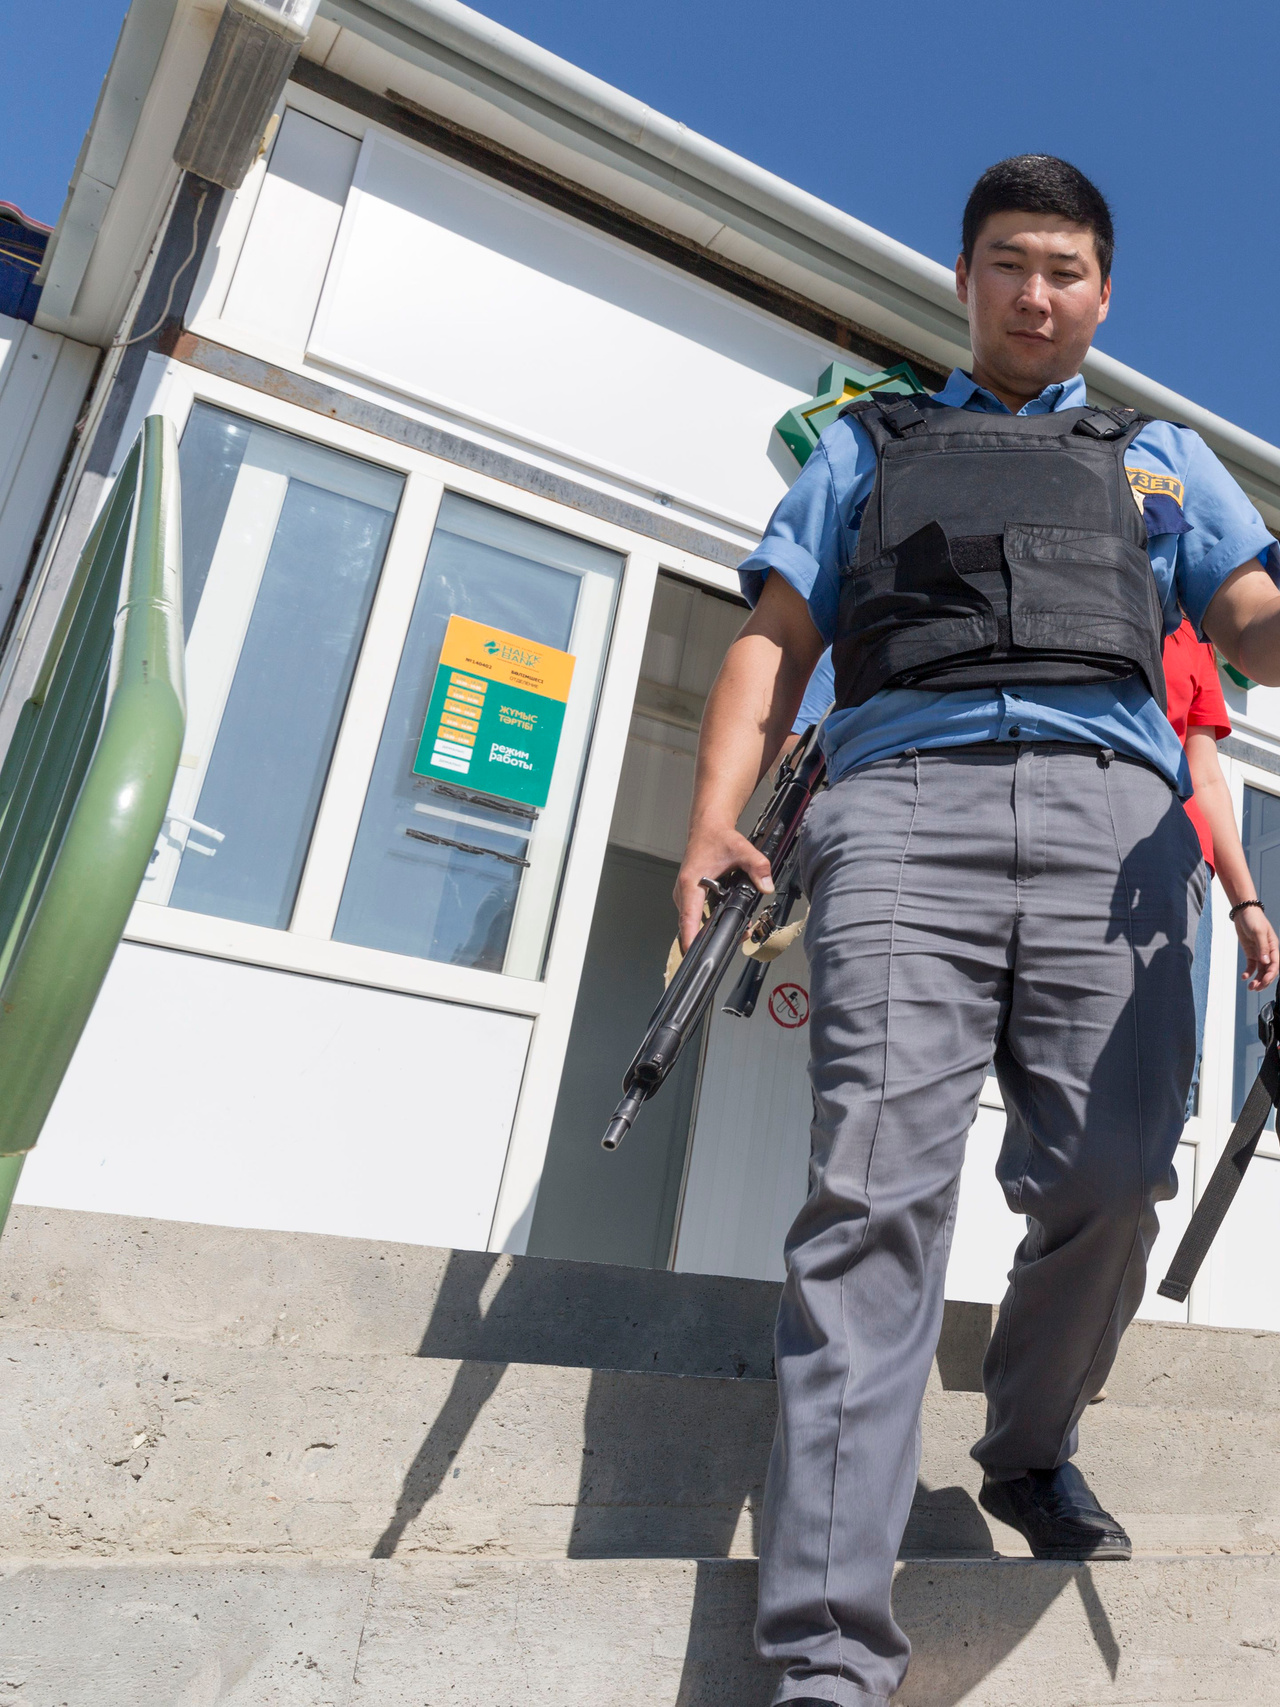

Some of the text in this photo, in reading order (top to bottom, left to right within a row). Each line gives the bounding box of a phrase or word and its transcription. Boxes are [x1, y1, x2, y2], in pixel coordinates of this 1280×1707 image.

[501, 652, 536, 668] BANK
[502, 645, 541, 664] HALYK
[489, 742, 530, 760] режим
[488, 752, 533, 771] работы
